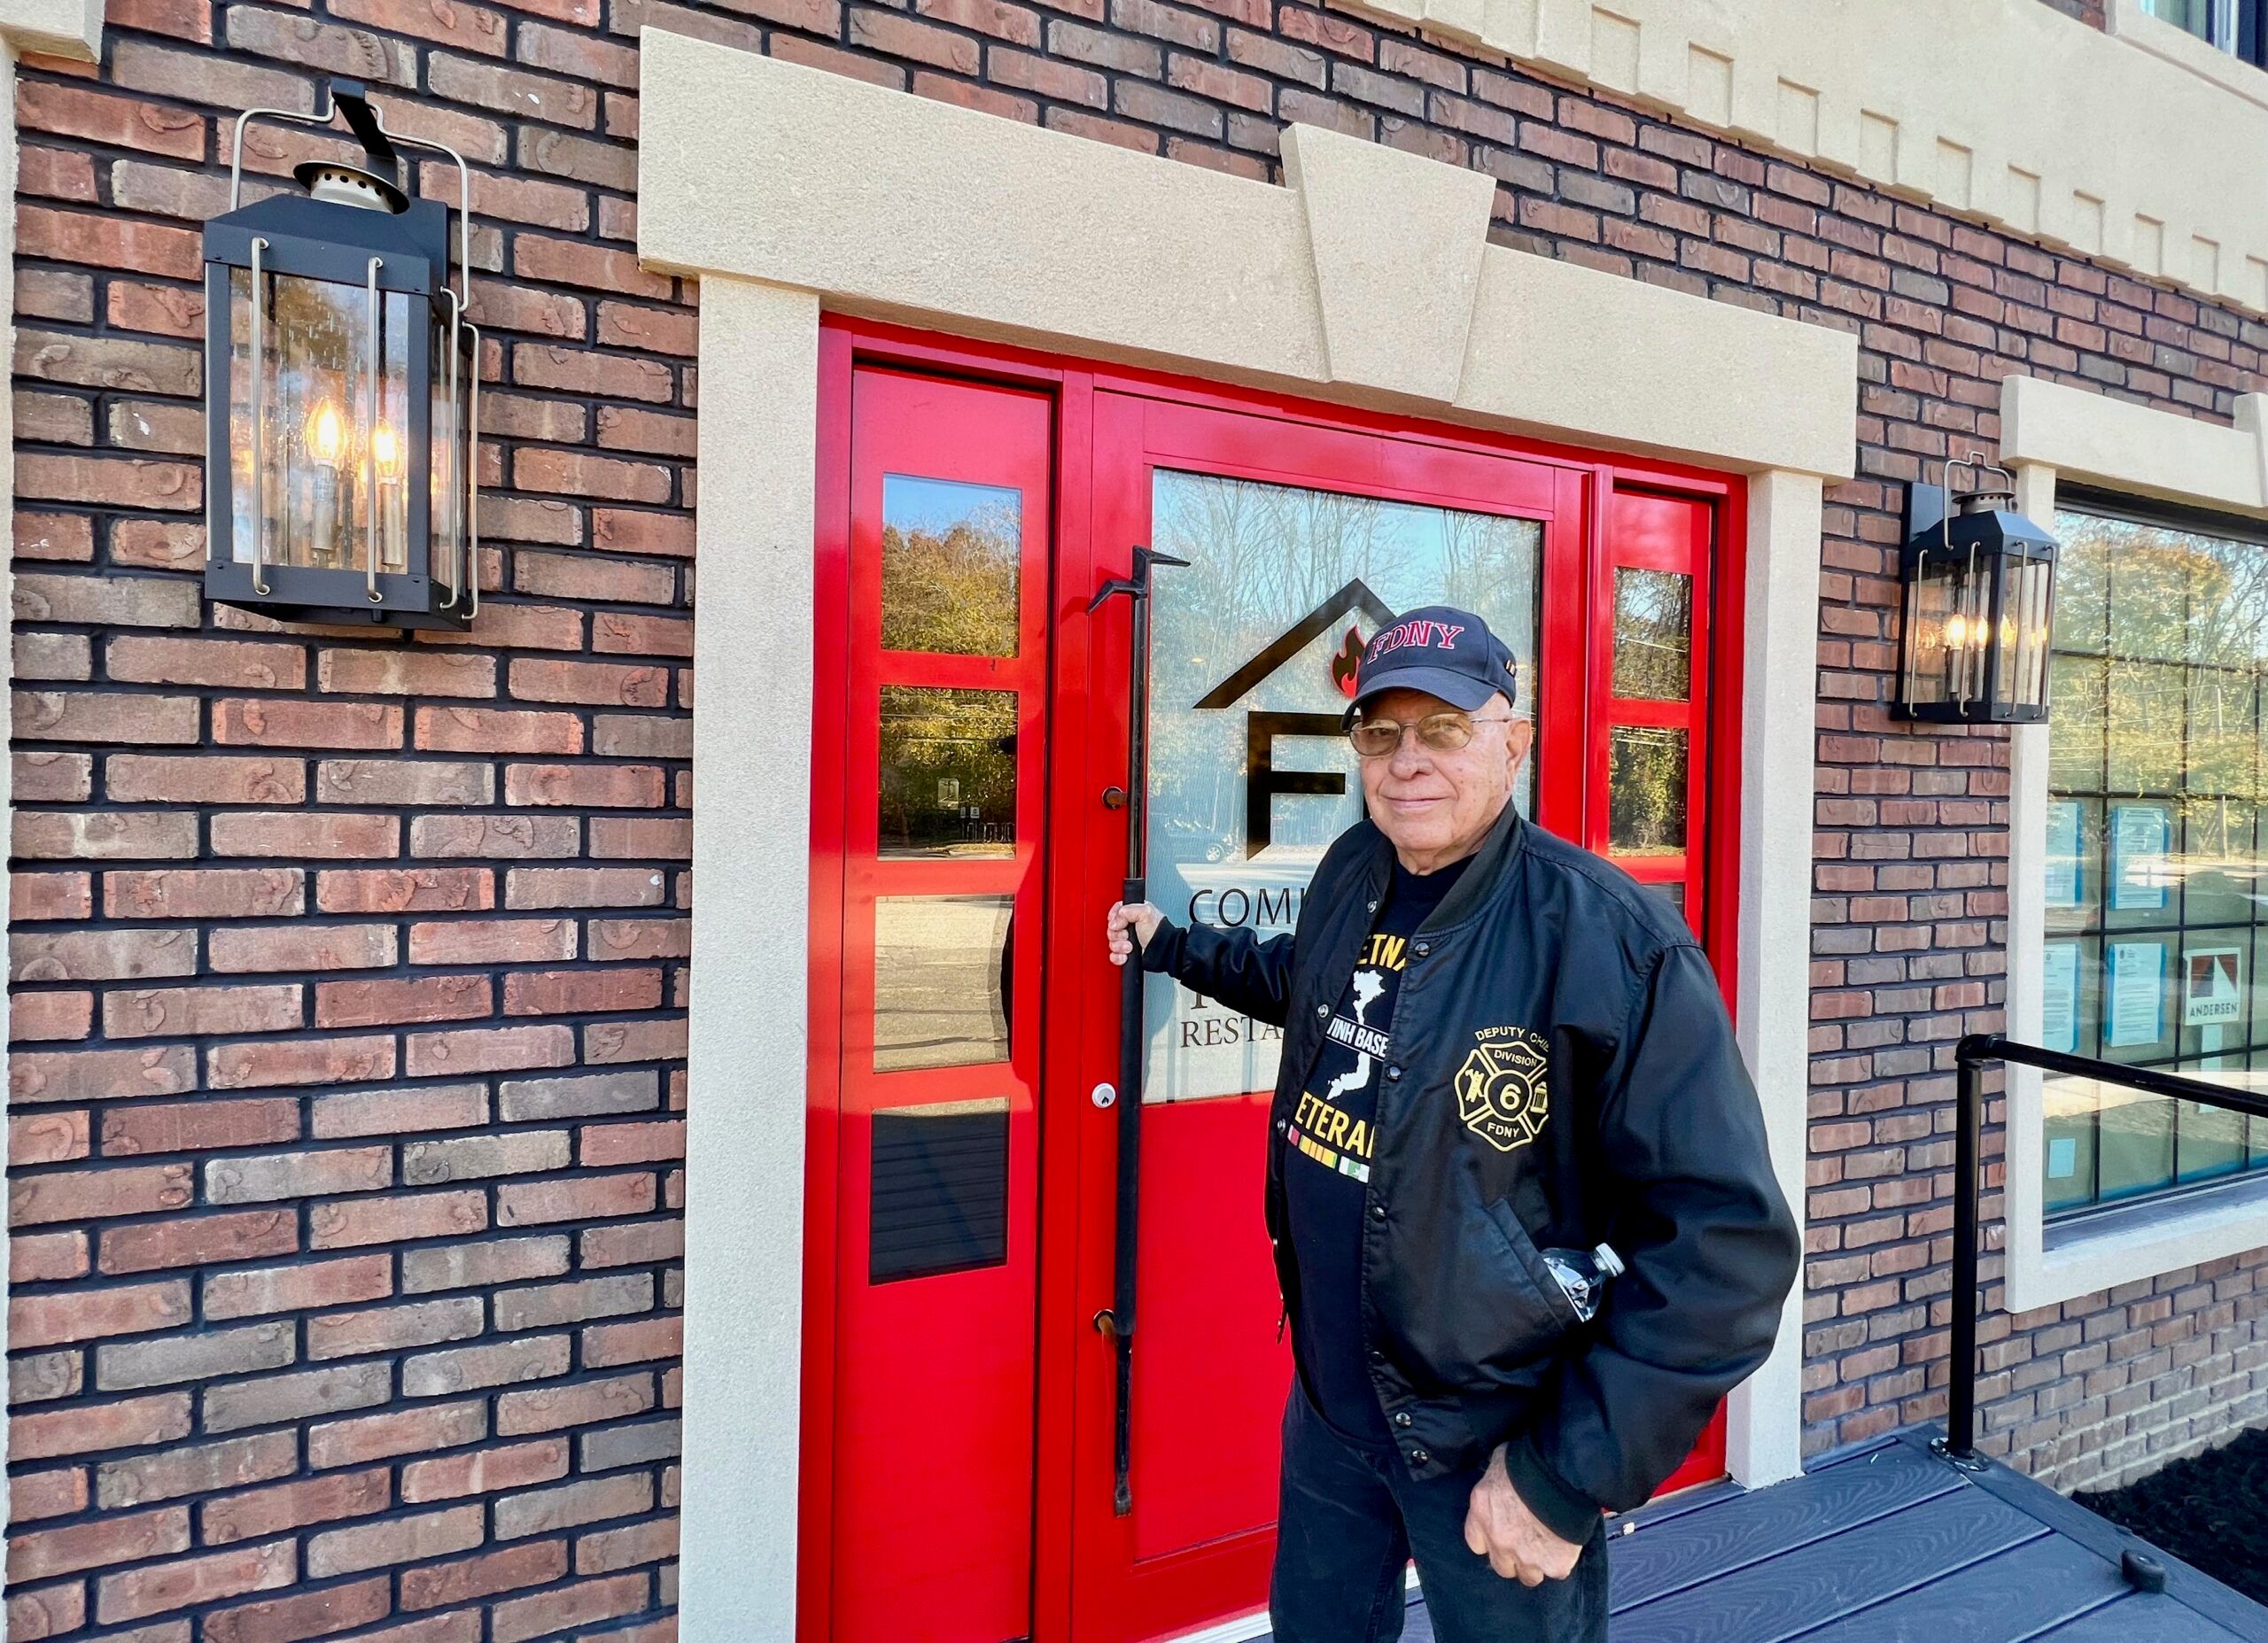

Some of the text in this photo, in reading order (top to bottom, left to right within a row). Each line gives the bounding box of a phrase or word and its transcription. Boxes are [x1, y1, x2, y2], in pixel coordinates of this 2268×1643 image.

[1367, 620, 1464, 664] FDNY
[1189, 887, 1304, 927] COM
[2189, 1003, 2238, 1018] ANDERSEN
[1355, 1027, 1389, 1058] BASE
[1474, 1027, 1525, 1041] DEPUTY
[1494, 1050, 1537, 1066] DIVISION
[1499, 1083, 1521, 1111] 6
[1487, 1121, 1520, 1138] FDNY
